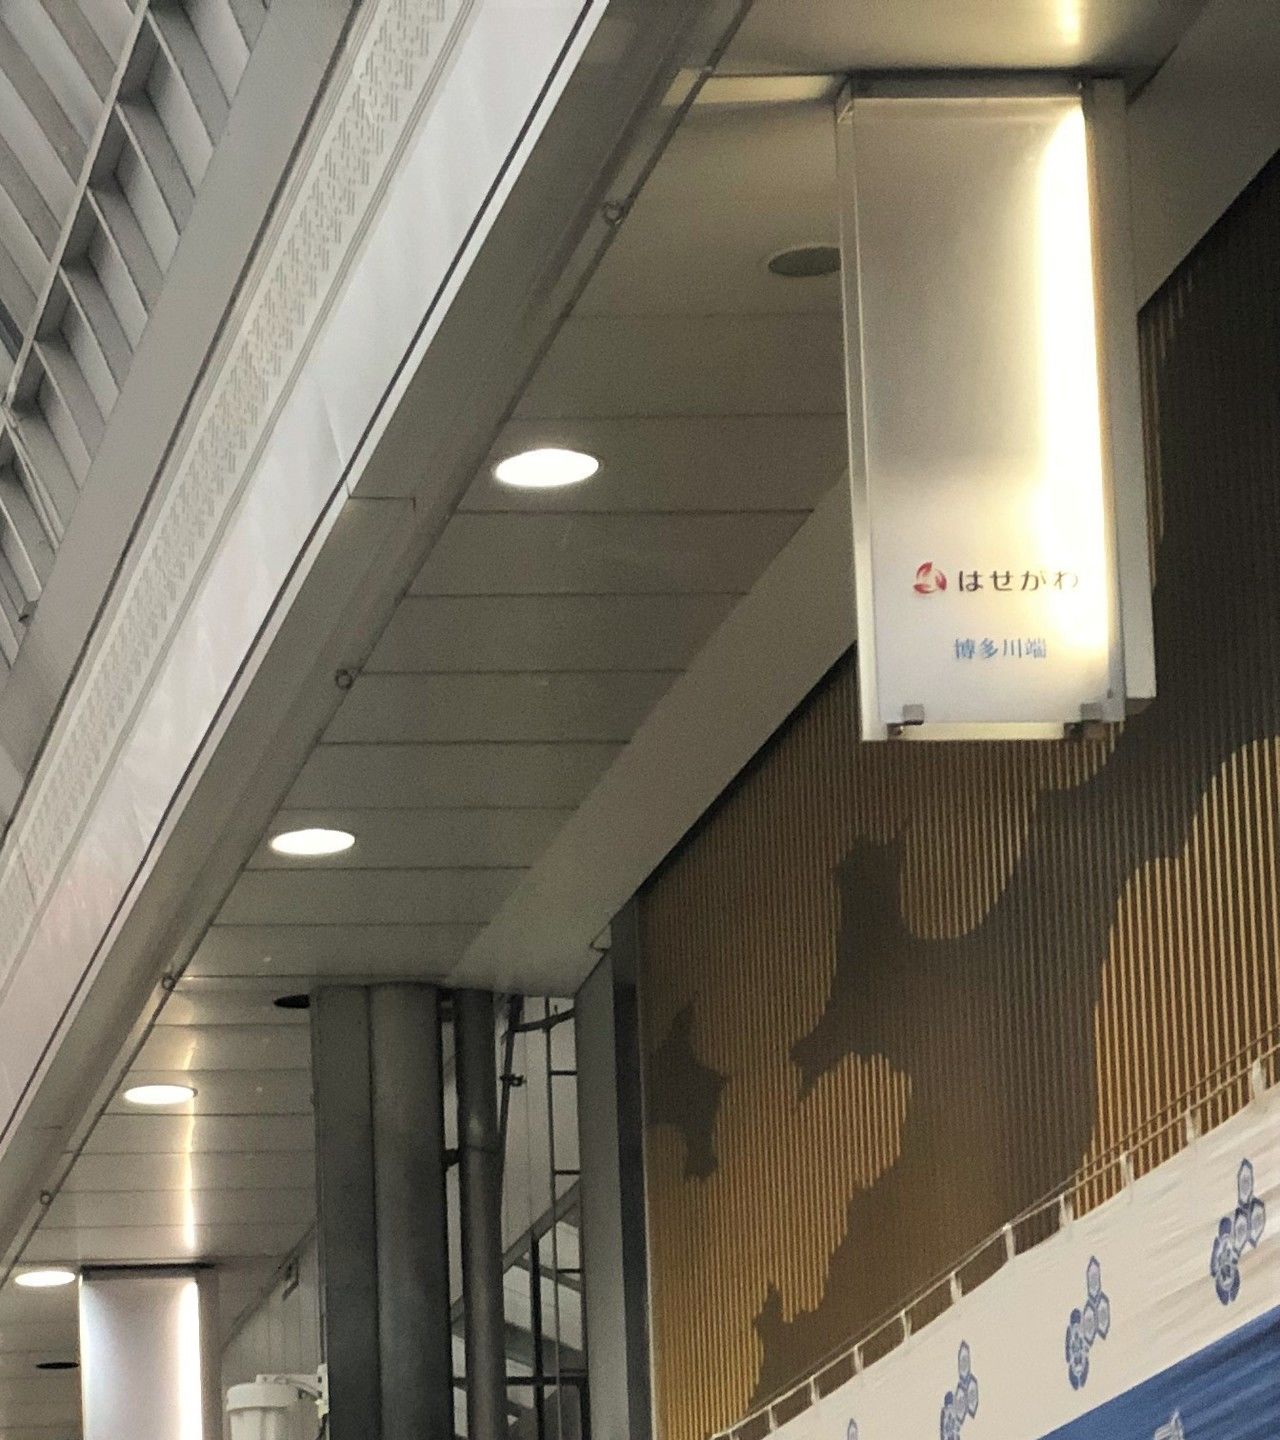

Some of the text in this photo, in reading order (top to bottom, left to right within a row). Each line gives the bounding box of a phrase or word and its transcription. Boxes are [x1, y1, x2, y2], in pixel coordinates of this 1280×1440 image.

[957, 569, 1079, 593] はせがわ
[954, 636, 1047, 659] 博多川端
